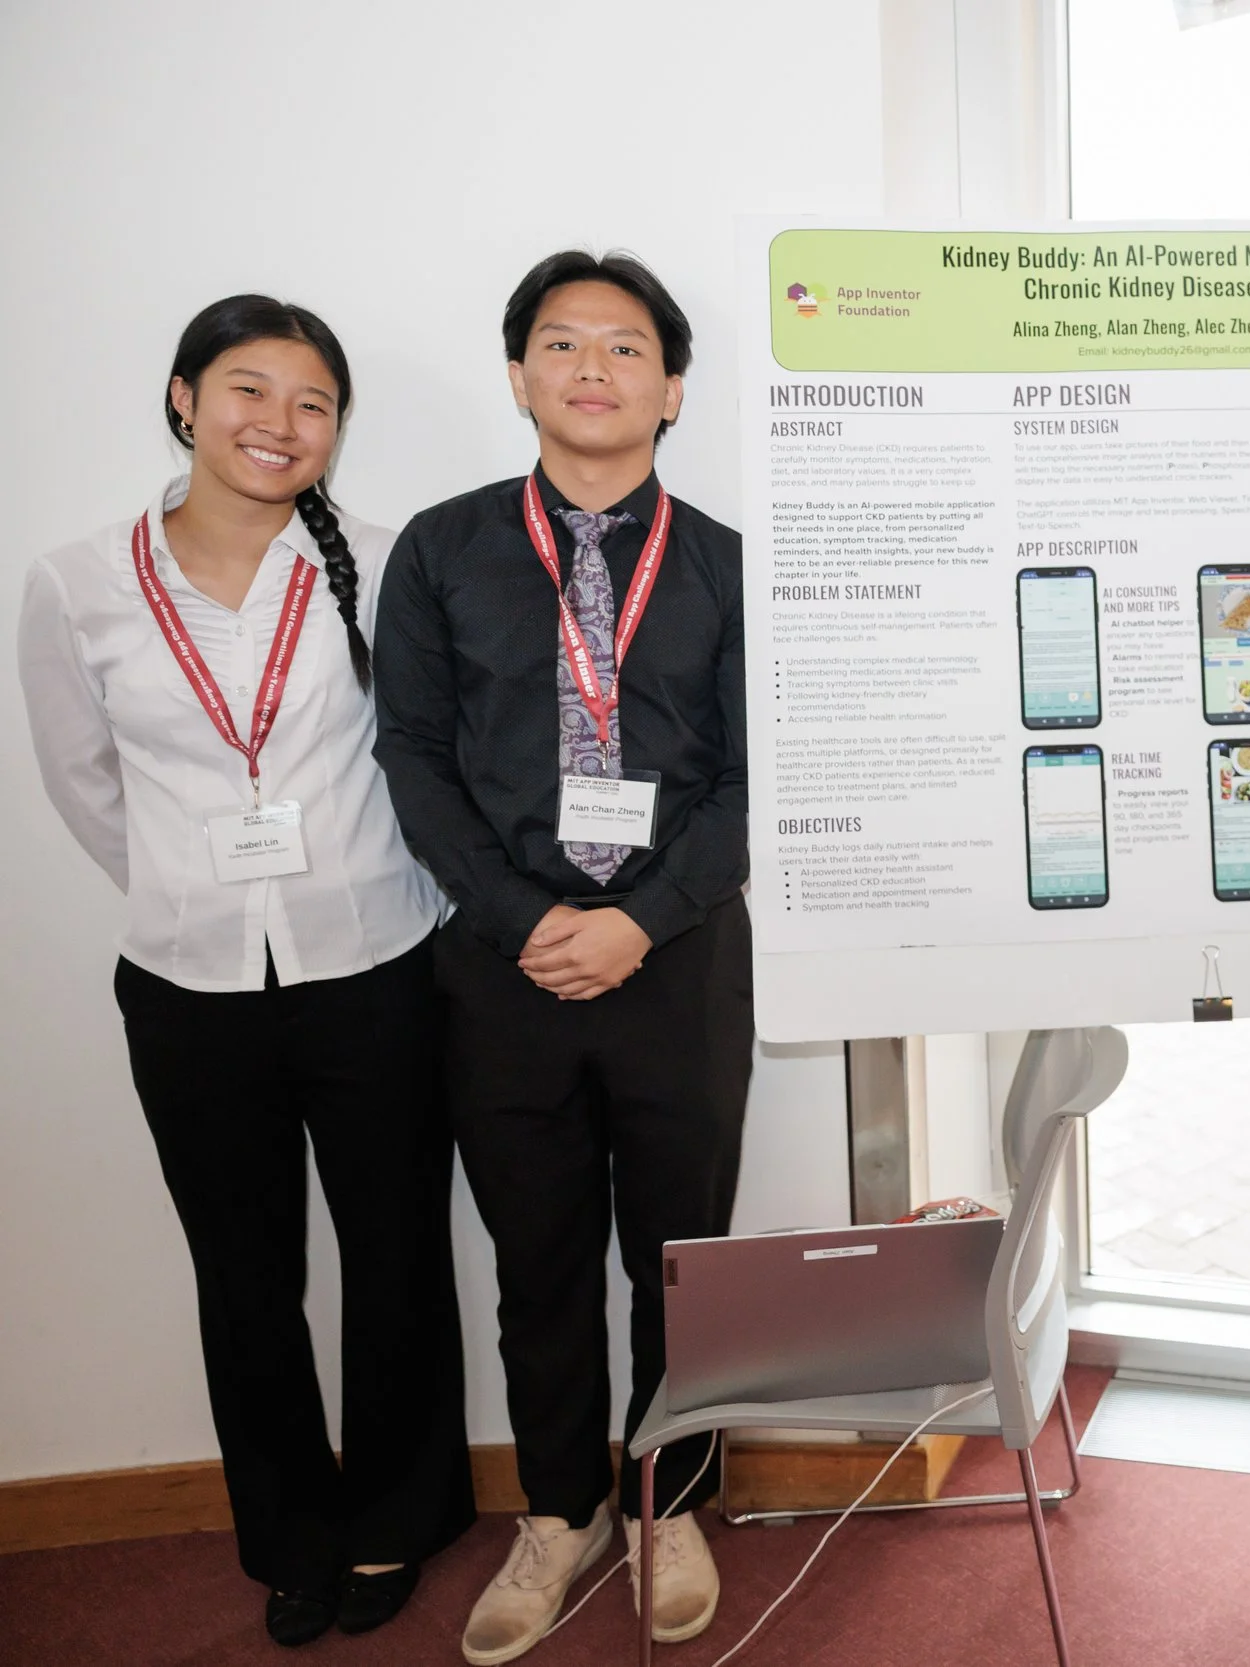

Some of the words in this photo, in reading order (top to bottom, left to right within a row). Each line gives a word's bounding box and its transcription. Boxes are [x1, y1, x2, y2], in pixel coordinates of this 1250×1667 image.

[943, 246, 1009, 271] Kidney
[1018, 247, 1085, 271] Buddy:
[1094, 246, 1117, 267] An
[1126, 245, 1237, 266] AI-Powered
[837, 287, 860, 301] App
[867, 288, 921, 300] Inventor
[1025, 278, 1100, 299] Chronic
[1109, 276, 1174, 301] Kidney
[838, 305, 909, 316] Foundation
[1013, 321, 1048, 337] Alina
[1055, 321, 1101, 339] Zheng,
[1107, 320, 1137, 335] Alan
[1144, 319, 1189, 338] Zheng,
[1195, 319, 1225, 334] Alec
[770, 385, 923, 407] INTRODUCTION
[1013, 386, 1051, 406] APP
[1060, 384, 1130, 406] DESIGN
[771, 422, 842, 436] ABSTRACT
[1014, 421, 1065, 435] SYSTEM
[1071, 419, 1118, 434] DESIGN
[773, 502, 803, 511] Kidney
[806, 502, 835, 511] Buddy
[947, 500, 995, 510] application
[773, 514, 814, 522] designed
[829, 514, 862, 522] support
[888, 513, 924, 521] patients
[927, 513, 936, 521] by
[939, 512, 970, 521] putting
[908, 524, 964, 532] personalized
[824, 537, 865, 545] symptom
[914, 548, 933, 556] your
[957, 546, 984, 554] buddy
[1017, 542, 1043, 557] APP
[1049, 540, 1137, 556] DESCRIPTION
[823, 572, 842, 580] your
[773, 586, 839, 600] PROBLEM
[845, 585, 921, 599] STATEMENT
[1103, 588, 1112, 598] AI
[1116, 586, 1177, 598] CONSULTING
[291, 588, 304, 611] World
[1104, 602, 1123, 613] AND
[1127, 601, 1154, 612] MORE
[1159, 601, 1180, 611] TIPS
[178, 641, 189, 656] App
[274, 620, 294, 666] Competition
[574, 648, 596, 699] Winner
[1112, 753, 1135, 764] REAL
[1139, 752, 1161, 764] TIME
[1113, 767, 1161, 779] TRACKING
[569, 804, 589, 812] Alan
[592, 805, 614, 814] Chan
[618, 807, 645, 817] Zheng
[779, 817, 861, 834] OBJECTIVES
[235, 839, 262, 850] Isabel
[264, 839, 278, 847] Lin
